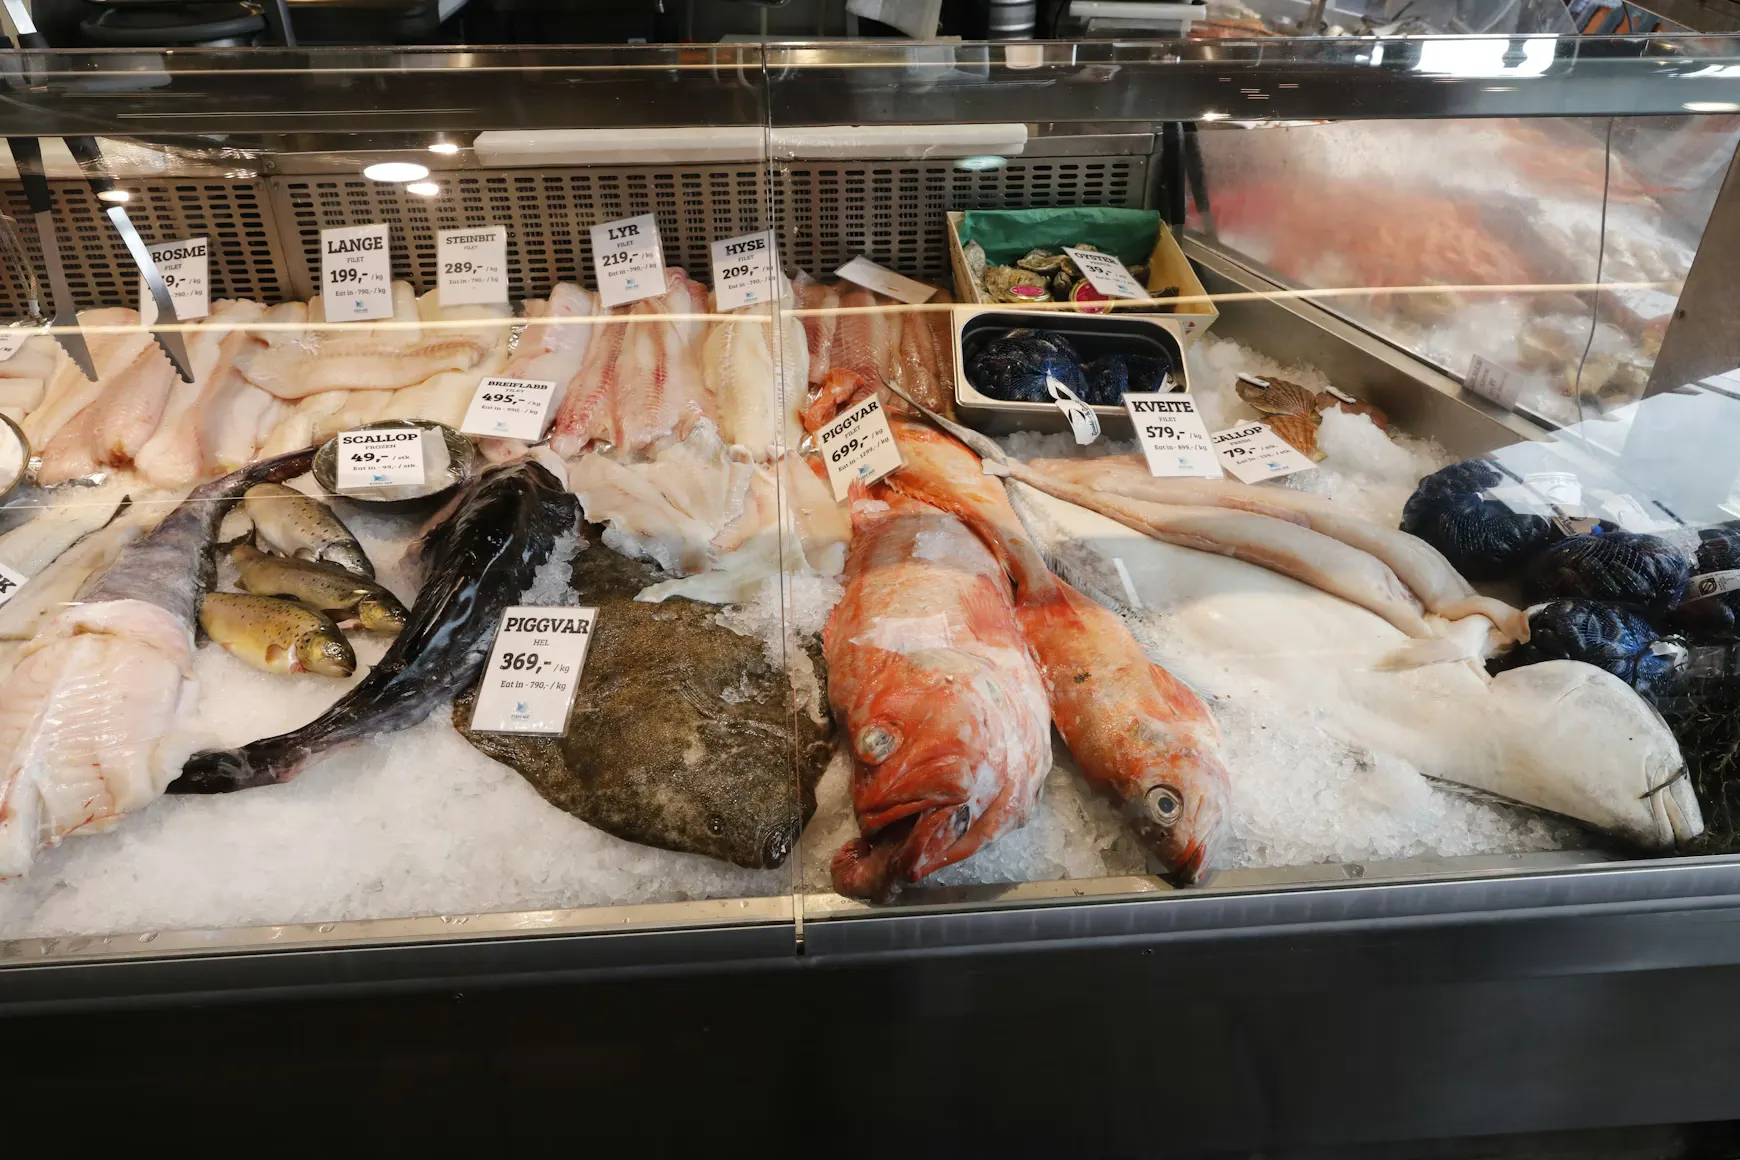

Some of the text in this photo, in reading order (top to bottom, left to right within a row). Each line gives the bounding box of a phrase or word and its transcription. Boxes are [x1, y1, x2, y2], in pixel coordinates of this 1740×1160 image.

[608, 224, 640, 240] LYR
[327, 236, 384, 254] LANGE
[445, 233, 496, 245] STEINBIT
[616, 240, 634, 248] FILET
[725, 238, 765, 256] HYSE
[152, 245, 206, 263] ROSME
[602, 251, 638, 267] 219,-
[737, 254, 754, 262] FILET
[1074, 252, 1119, 265] OYSTER
[164, 263, 182, 271] FILET
[444, 261, 483, 274] 289,-
[722, 265, 759, 280] 209,-
[1085, 264, 1112, 276] 39,-
[330, 268, 368, 284] 199,-
[487, 380, 548, 390] BREIFLABB
[482, 393, 525, 405] 495,-
[1131, 401, 1194, 413] KVEITE
[821, 401, 879, 444] PIGGVAR
[844, 425, 861, 439] FILET
[1145, 425, 1185, 440] 579,-
[343, 433, 418, 445] SCALLOP
[831, 435, 868, 463] 699,-
[874, 428, 884, 436] kg
[351, 452, 389, 463] 49,-
[838, 463, 849, 472] Eat
[880, 437, 890, 445] kg
[1222, 447, 1256, 458] 79,-
[504, 617, 590, 634] PIGGVAR
[499, 652, 552, 674] 369,-
[559, 664, 570, 674] kg
[500, 680, 514, 689] Eat
[515, 680, 524, 688] in
[529, 681, 549, 690] 790,-
[556, 682, 566, 691] kg
